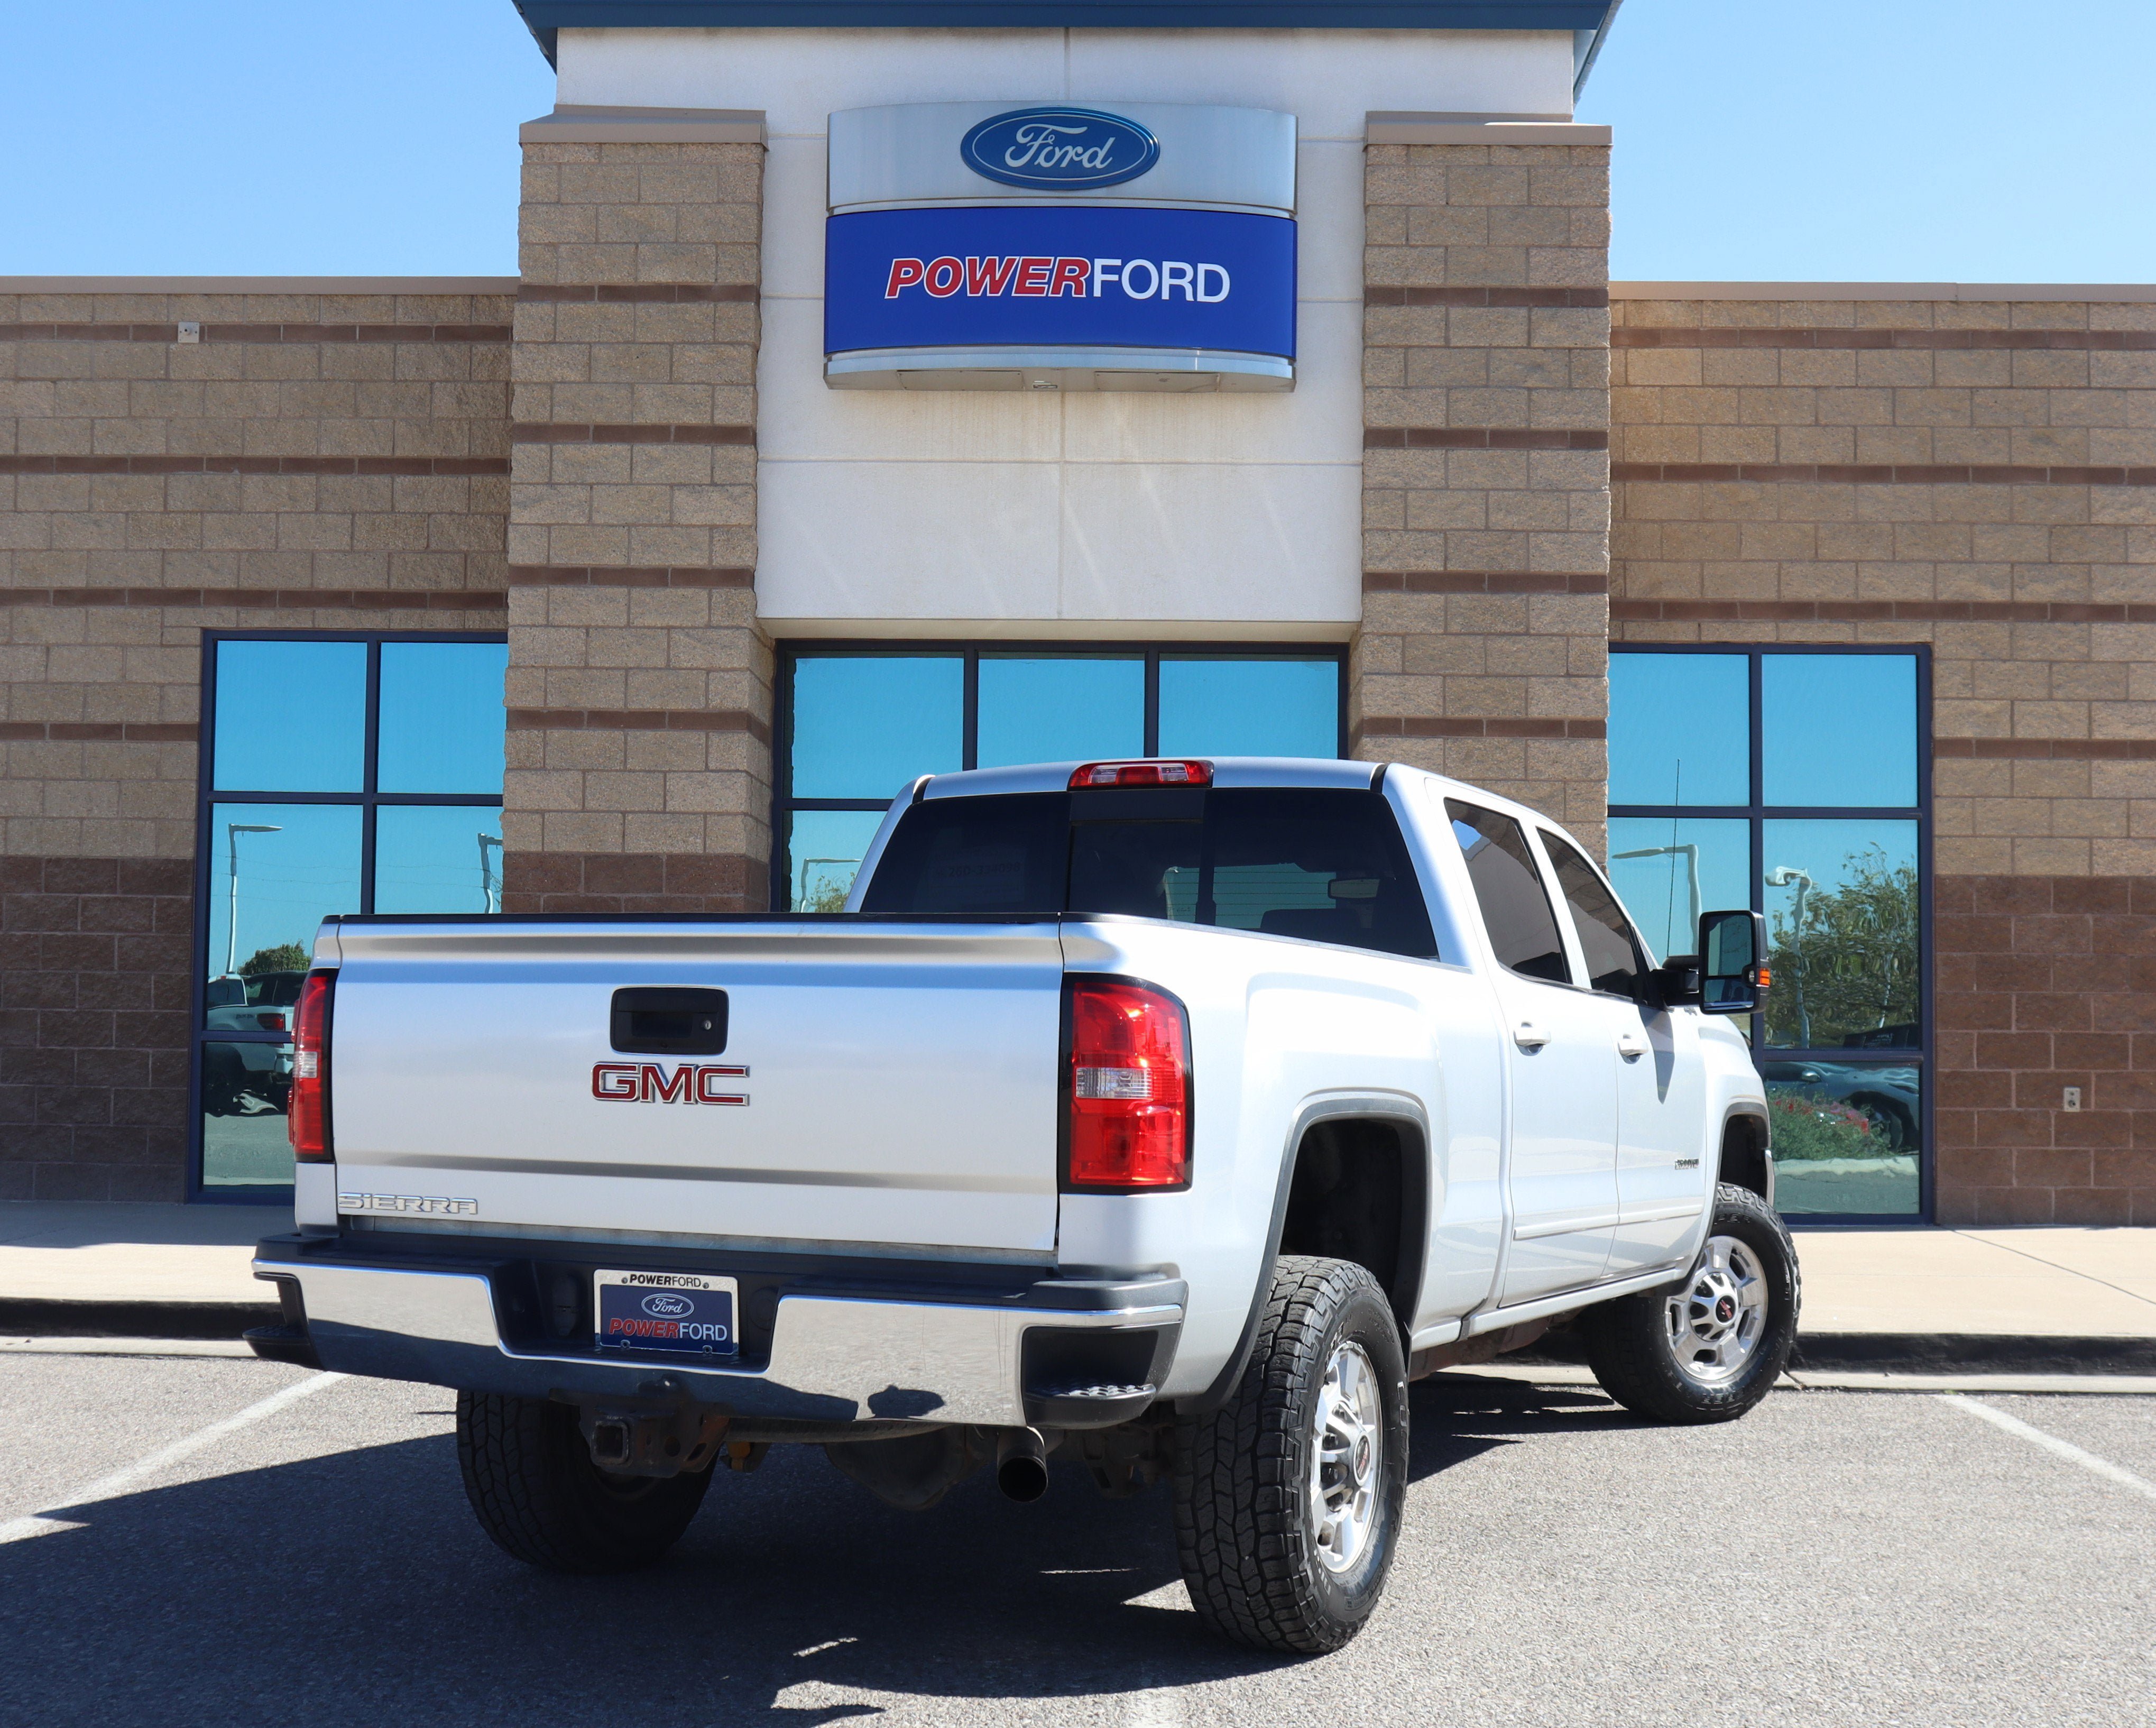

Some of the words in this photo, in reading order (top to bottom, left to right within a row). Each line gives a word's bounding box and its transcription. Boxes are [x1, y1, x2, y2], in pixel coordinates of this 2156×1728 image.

[1004, 123, 1116, 169] Ford
[884, 256, 1231, 302] POWERFORD
[591, 1061, 750, 1106] GMC
[338, 1192, 478, 1215] SIERRA
[630, 1274, 701, 1288] POWERFORD
[652, 1297, 683, 1314] Ford
[609, 1318, 728, 1341] POWERFORD
